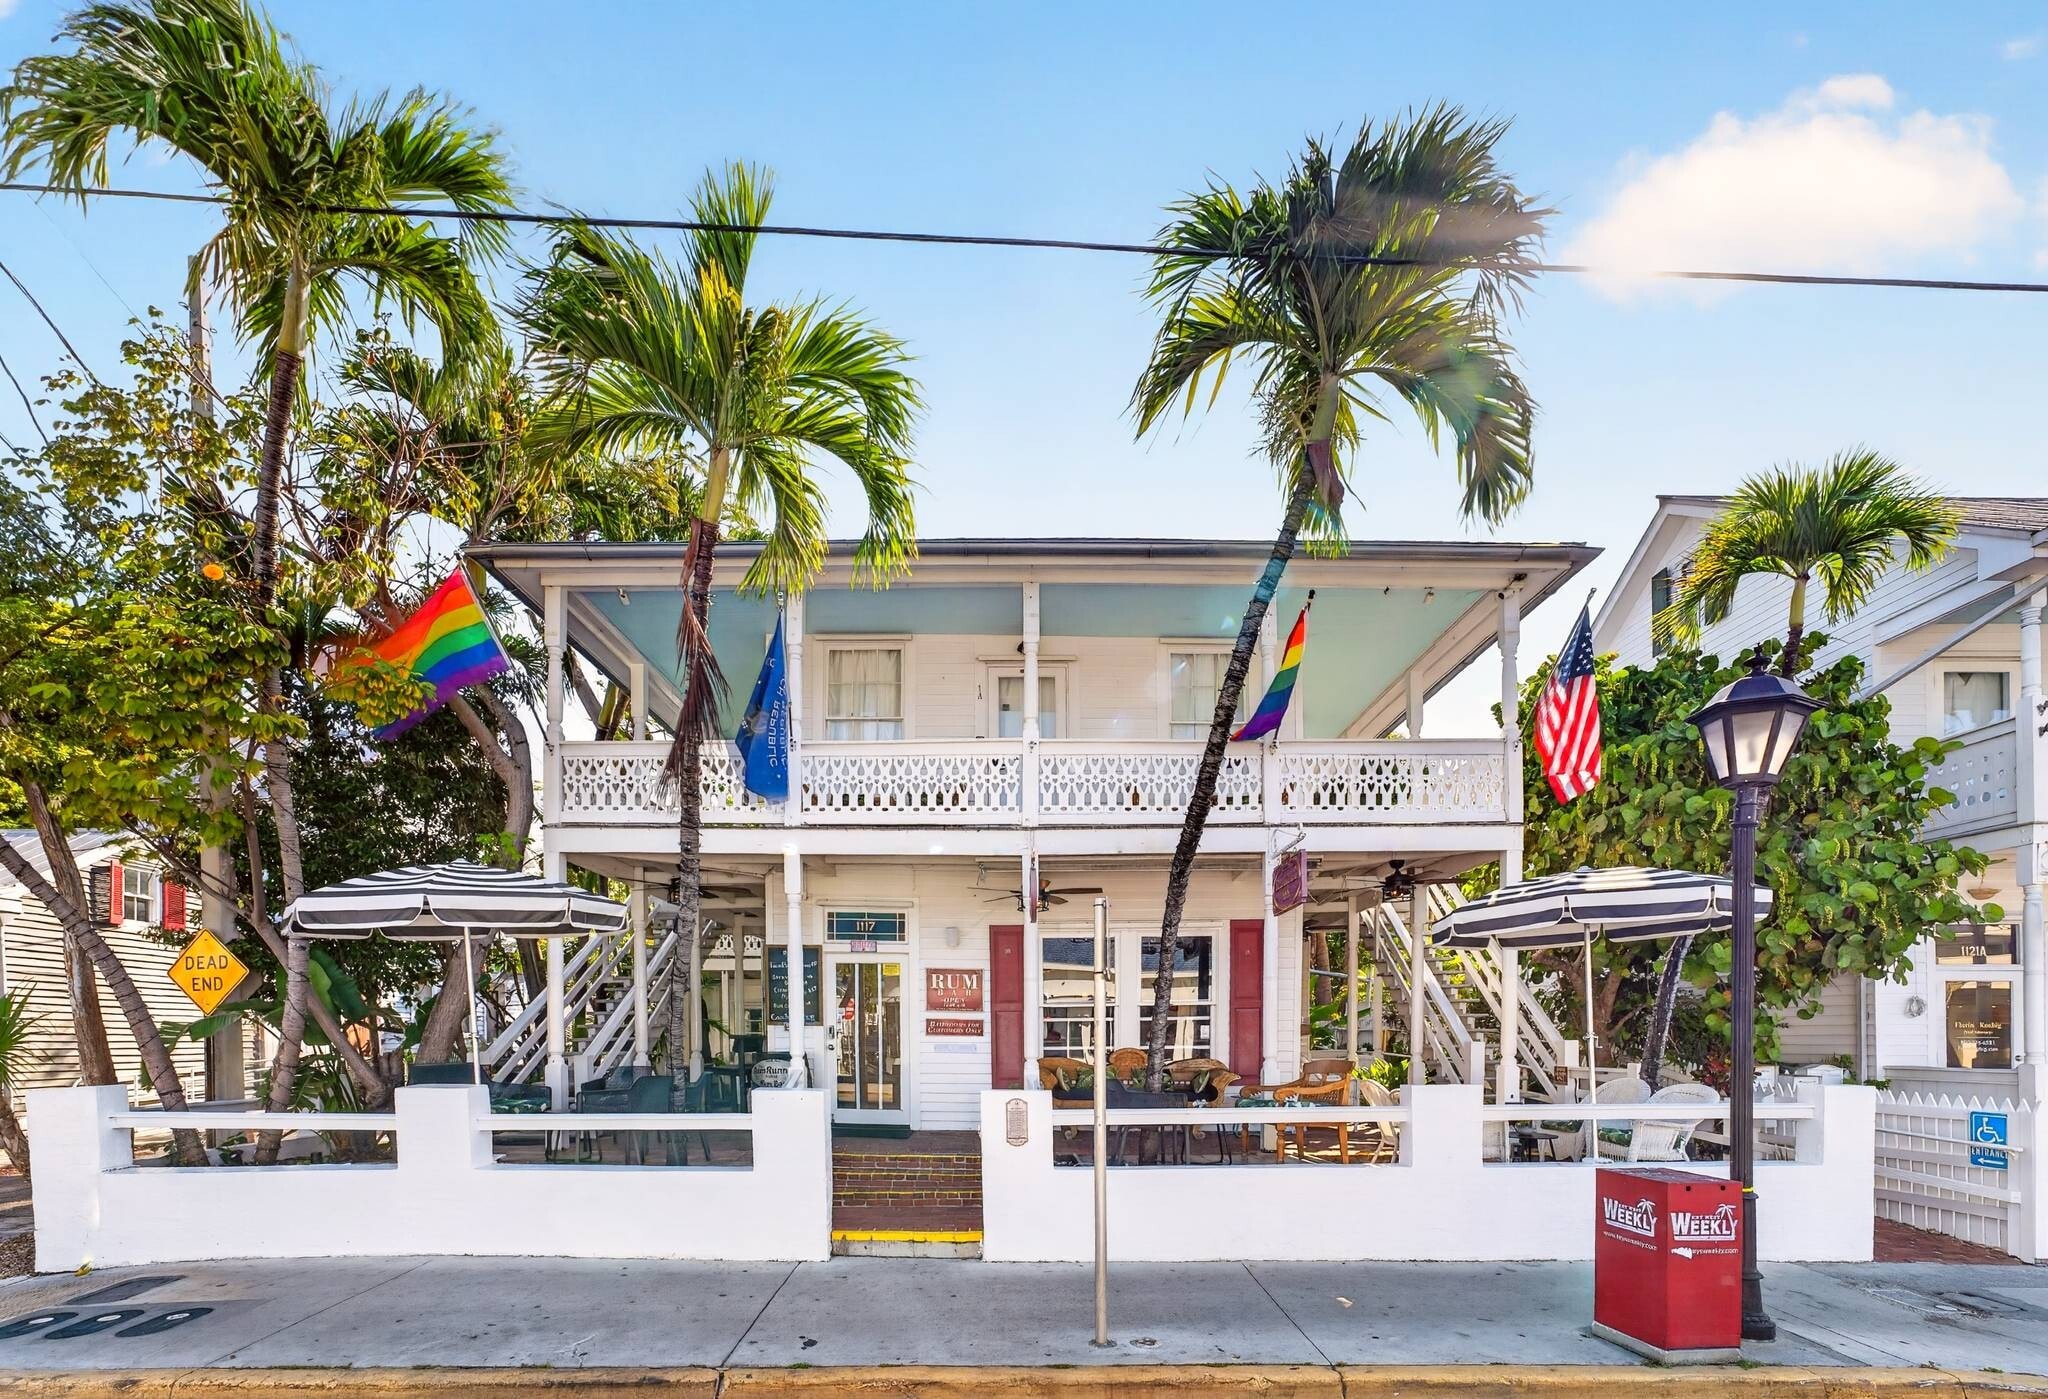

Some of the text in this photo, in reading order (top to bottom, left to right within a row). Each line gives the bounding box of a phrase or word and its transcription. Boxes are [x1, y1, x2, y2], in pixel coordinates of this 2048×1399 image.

[856, 921, 876, 931] 1117
[1961, 945, 1987, 956] 1121A
[185, 955, 228, 970] DEAD
[192, 976, 223, 992] END
[930, 973, 979, 990] RUM
[766, 1065, 788, 1075] Runn
[1603, 1197, 1658, 1237] WEEKLY
[1670, 1212, 1738, 1238] WEEKLY
